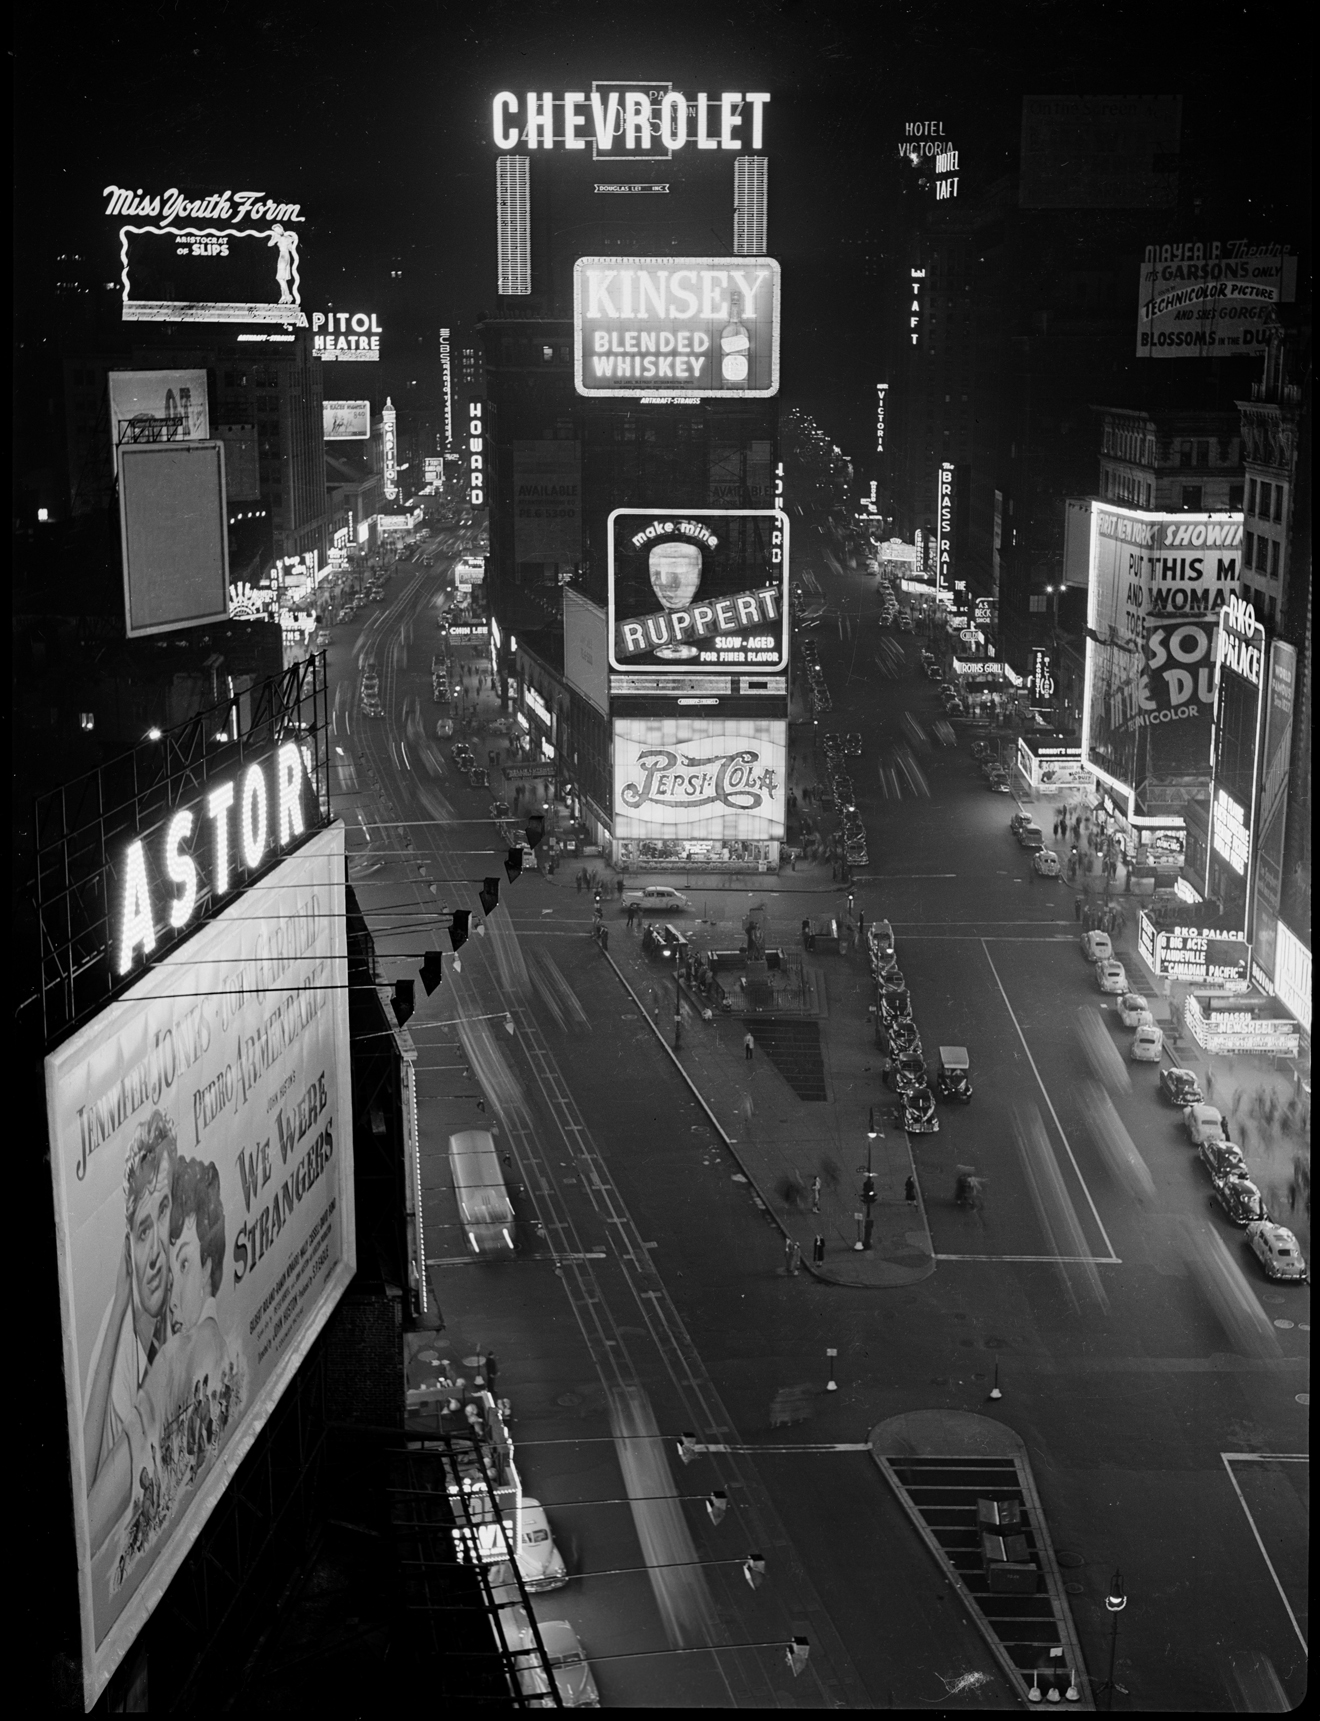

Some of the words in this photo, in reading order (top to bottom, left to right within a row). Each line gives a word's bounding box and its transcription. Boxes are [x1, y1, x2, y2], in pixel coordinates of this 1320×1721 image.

[492, 90, 771, 150] CHEVROLET
[905, 121, 946, 136] HOTEL
[898, 142, 954, 157] VICTORIA
[935, 151, 960, 174] HOTEL
[935, 177, 960, 200] TAFT
[103, 185, 161, 216] Miss
[159, 187, 233, 227] Youth
[231, 191, 306, 224] Form
[175, 236, 229, 245] ARISTOCRAT
[191, 244, 230, 257] SLIPS
[1145, 241, 1222, 263] MAYFAIR
[1226, 237, 1292, 260] Theatre
[1251, 266, 1283, 279] ONLY
[585, 269, 771, 320] KINSEY
[1143, 282, 1228, 320] TECHNICOLOR
[1230, 283, 1275, 301] PICTURE
[298, 311, 383, 333] APITOL
[910, 283, 921, 345] TAFT
[1173, 309, 1195, 321] AND
[1218, 306, 1268, 320] GORGE
[314, 335, 380, 350] HEATRE
[594, 331, 709, 353] BLENDED
[1140, 330, 1217, 348] BLOSSOMS
[1217, 336, 1227, 346] IN
[1227, 336, 1242, 346] THE
[1242, 329, 1267, 346] DU
[593, 356, 706, 377] WHISKEY
[876, 390, 885, 452] VICTORIA
[384, 422, 396, 489] CAPITOL
[469, 402, 484, 505] HOWARD
[941, 471, 952, 532] BRASS
[631, 519, 674, 548] make
[680, 521, 720, 549] mine
[1098, 513, 1118, 536] FIRST
[1117, 518, 1133, 541] NEW
[940, 539, 950, 587] RAIL
[1128, 552, 1144, 579] PUT
[1147, 557, 1204, 582] THIS
[954, 580, 967, 591] THE
[1126, 582, 1144, 609] AND
[621, 589, 780, 653] RUPPERT
[974, 608, 992, 618] BECK
[1228, 593, 1256, 638] RKO
[449, 626, 471, 635] CHIN
[472, 626, 489, 635] LEE
[962, 631, 979, 640] CHILD
[714, 636, 775, 649] SLOW-AGED
[700, 651, 718, 662] FOR
[719, 651, 746, 662] FINER
[747, 651, 780, 662] FLAVOR
[984, 662, 1003, 673] GRILL
[1220, 629, 1261, 686] PALACE
[1035, 651, 1043, 699] SPAGHETTI
[118, 741, 305, 978] ASTOR
[1169, 937, 1183, 949] BIG
[1186, 938, 1208, 951] ACTS
[1173, 926, 1198, 937] RKO
[1202, 928, 1245, 940] PALACE
[1160, 949, 1206, 964] VAUDEVILLE
[1210, 1012, 1252, 1023] EMBASSY
[1218, 1022, 1276, 1034] NEWSREEL
[76, 1053, 151, 1180] JENNIFER
[151, 997, 211, 1105] JONES
[221, 969, 253, 1033] JOHN
[254, 893, 321, 1007] GARFIELD
[192, 1063, 234, 1148] PEDRO
[234, 960, 328, 1115] ARMENDARIZ
[234, 1136, 272, 1214] WE
[274, 1070, 328, 1166] WERE
[232, 1116, 334, 1292] STRANGERS
